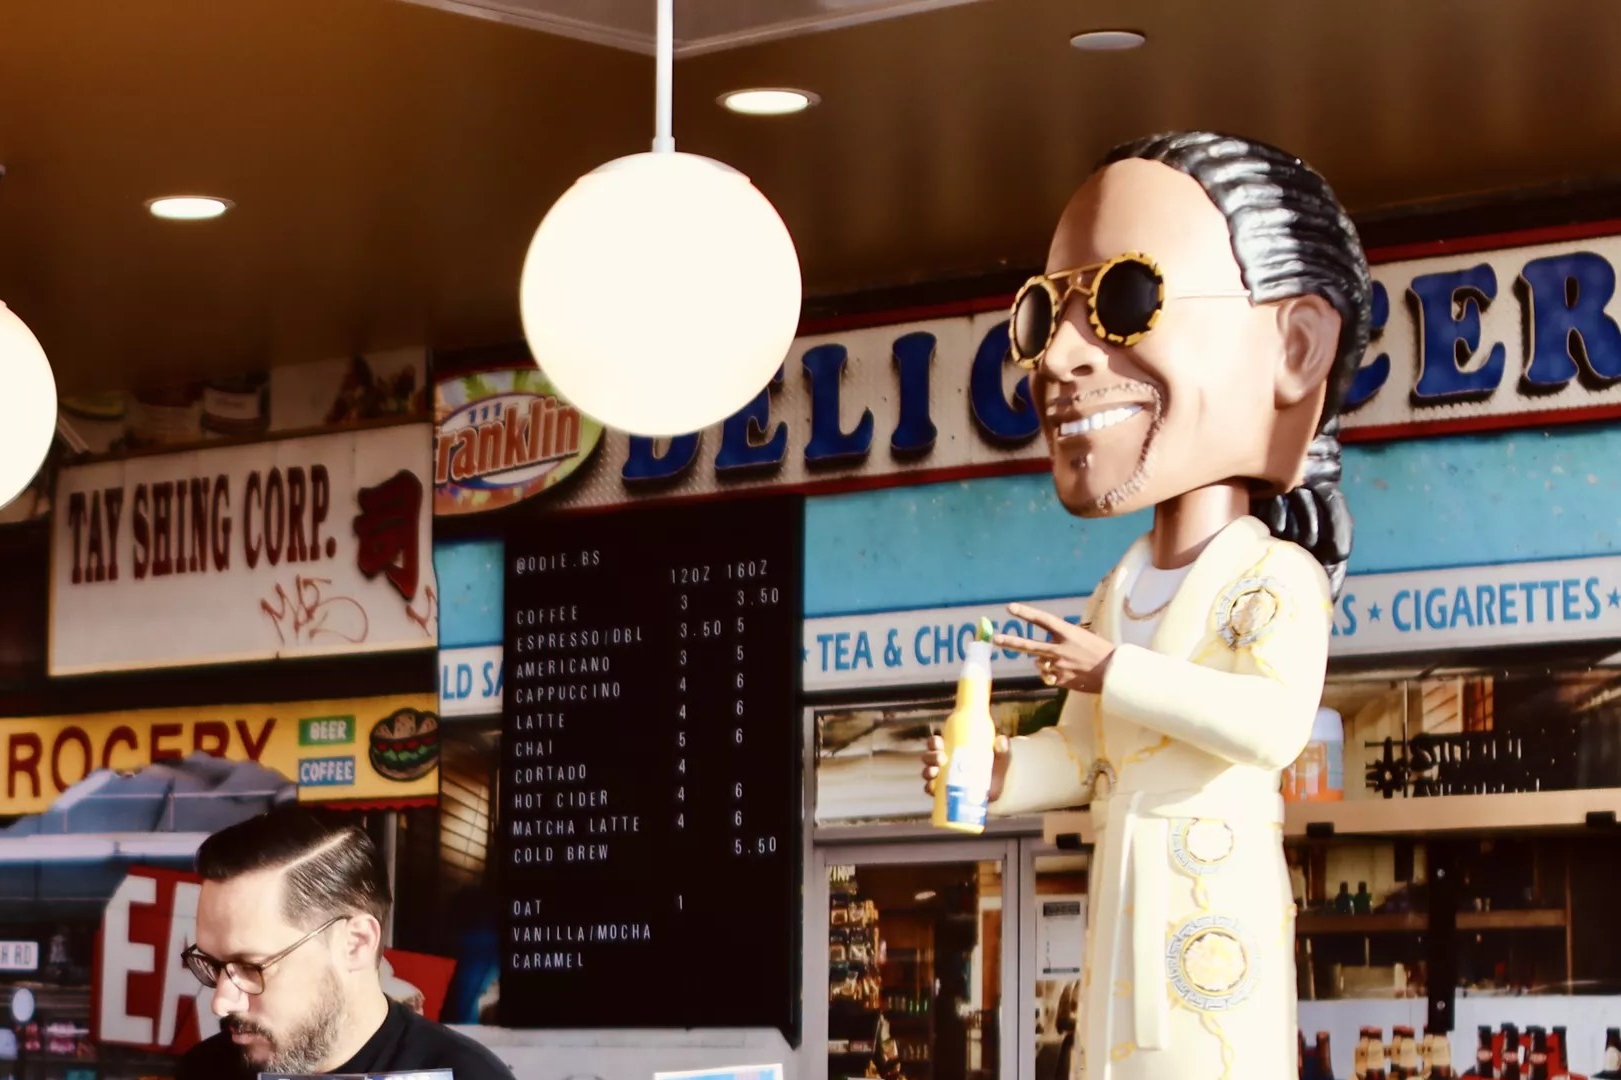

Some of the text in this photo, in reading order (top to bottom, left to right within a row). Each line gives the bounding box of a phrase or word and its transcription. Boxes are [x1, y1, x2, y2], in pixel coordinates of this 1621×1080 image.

[435, 396, 581, 483] ranklin
[68, 464, 337, 584] TAY SHING CORP.
[516, 550, 601, 574] @ODIE.BS
[516, 587, 779, 625] COFFEE 3 3.50
[516, 617, 745, 652] ESPRESSO/DBL 3.50 5
[817, 629, 873, 672] TEA
[884, 628, 904, 667] &
[1392, 577, 1602, 632] CIGARETTES
[516, 646, 744, 679] AMERICANO 3 5
[516, 673, 744, 704] CAPPUCCINO 4 6
[516, 700, 744, 730] LATTE 4 6
[309, 720, 347, 741] BEER
[515, 728, 743, 757] CHAI 5 6
[301, 760, 353, 782] COFFEE
[515, 759, 686, 784] CORTADO 4
[514, 783, 743, 809] HOT CIDER 4 6
[513, 811, 742, 837] MATCHA LATTE 4 6
[514, 837, 777, 864] COLD BREW 5.50
[513, 899, 542, 916] OAT
[513, 923, 651, 943] VANILLA/MOCHA
[513, 952, 583, 969] CARAMEL
